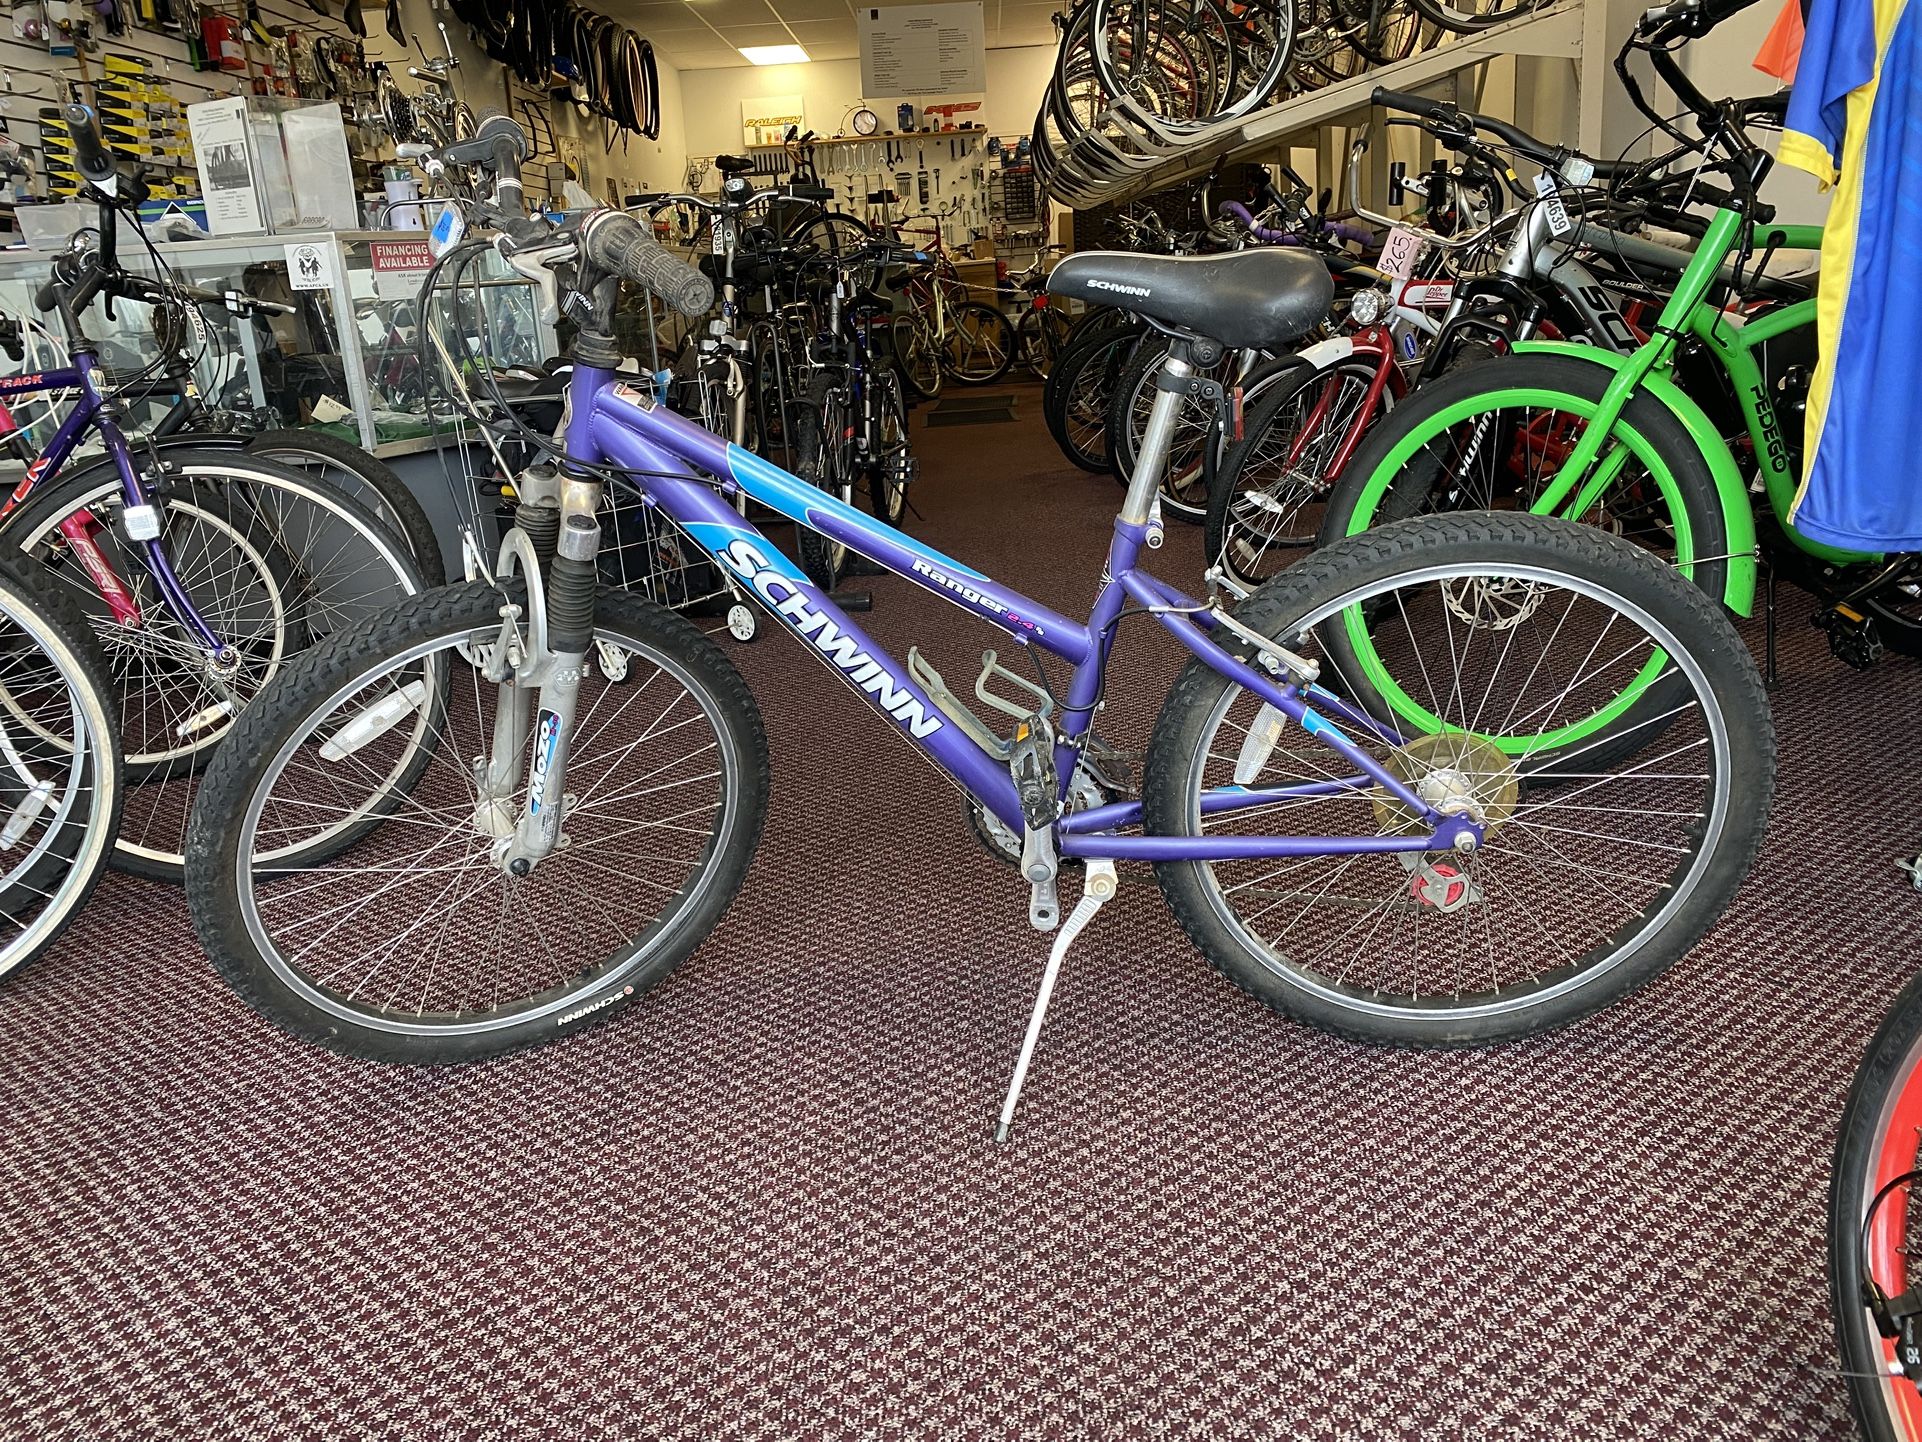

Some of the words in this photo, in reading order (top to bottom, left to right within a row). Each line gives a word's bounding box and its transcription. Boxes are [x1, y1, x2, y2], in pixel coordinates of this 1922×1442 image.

[745, 115, 803, 127] RALEIGH
[1541, 183, 1568, 231] 14639
[376, 245, 428, 256] FINANCING
[379, 256, 430, 269] AVAILABLE
[1087, 279, 1151, 297] SCHWINN
[1602, 279, 1644, 290] BOULDER
[1750, 382, 1787, 474] PEDEGO
[911, 558, 1008, 615] Ranger
[1007, 612, 1035, 631] 2.4
[717, 538, 945, 739] SCHWINN
[531, 720, 551, 806] MOZO
[557, 991, 625, 1026] SCHWINN
[1906, 1346, 1920, 1364] 26
